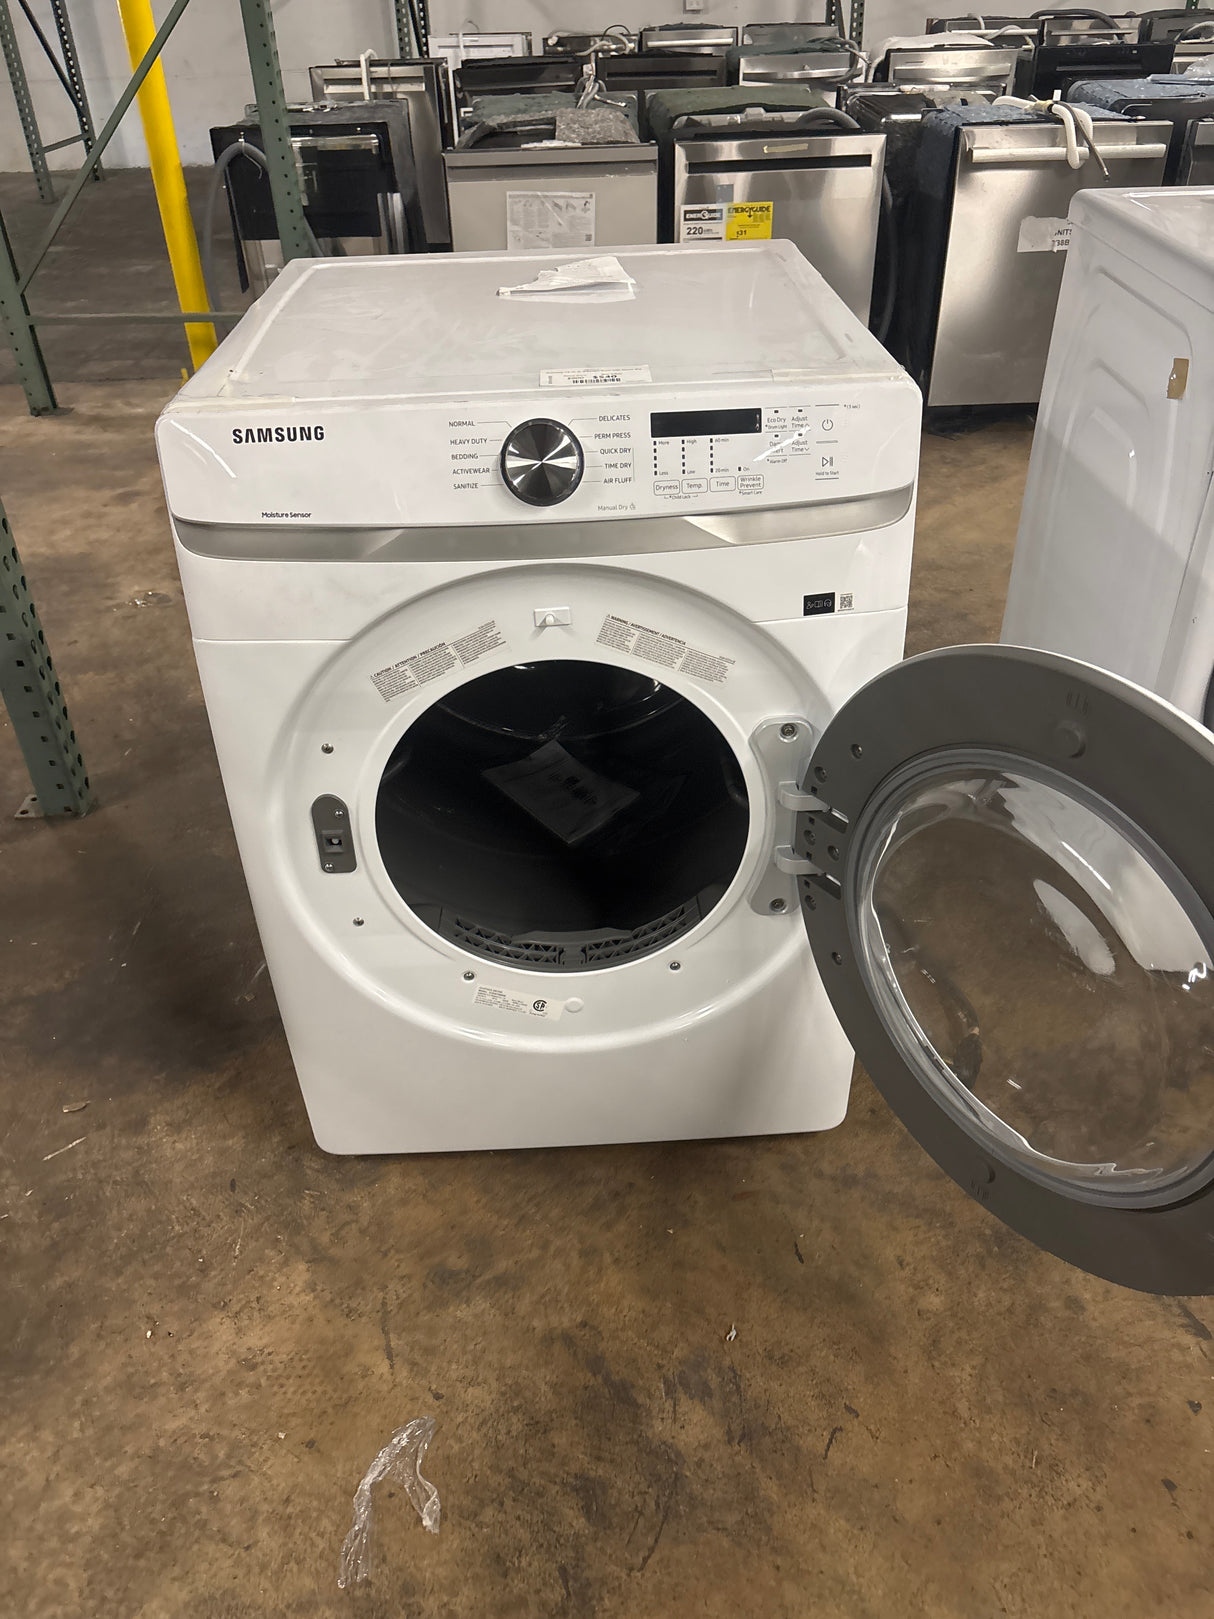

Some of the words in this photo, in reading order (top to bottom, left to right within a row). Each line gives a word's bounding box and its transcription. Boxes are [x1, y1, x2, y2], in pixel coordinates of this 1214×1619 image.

[687, 226, 703, 235] 220
[232, 425, 325, 444] SAMSUNG
[374, 666, 392, 678] CAUTION
